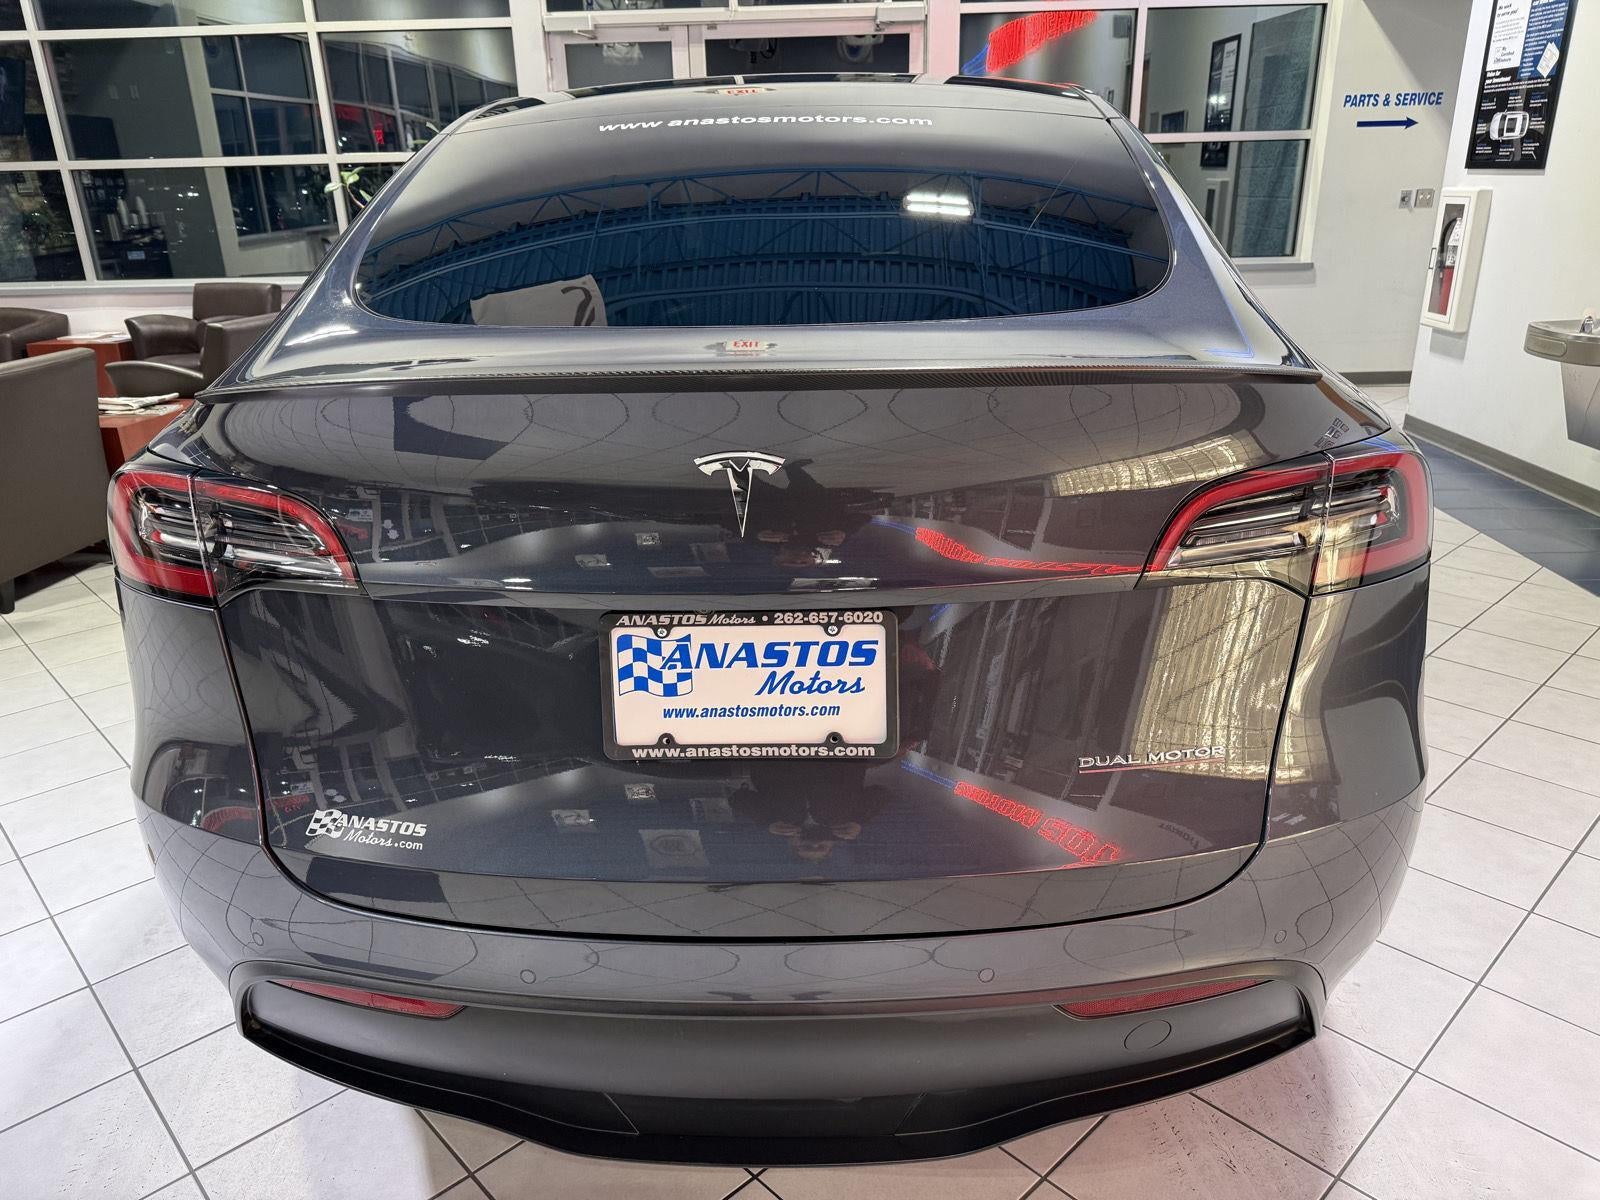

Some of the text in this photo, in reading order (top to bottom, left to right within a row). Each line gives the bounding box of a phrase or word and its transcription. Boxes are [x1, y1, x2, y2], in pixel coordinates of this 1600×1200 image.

[1343, 92, 1444, 108] PARTS & SERVICE
[616, 611, 884, 626] ANASTOS Motors 262-657-6020
[659, 640, 879, 669] ANASTOS
[754, 670, 866, 696] Motors
[662, 703, 841, 719] www.anastosmotors.com
[631, 745, 876, 759] www.anastosmotors.com
[1078, 745, 1227, 768] DUAL MOTOR
[333, 813, 428, 837] ANASTOS
